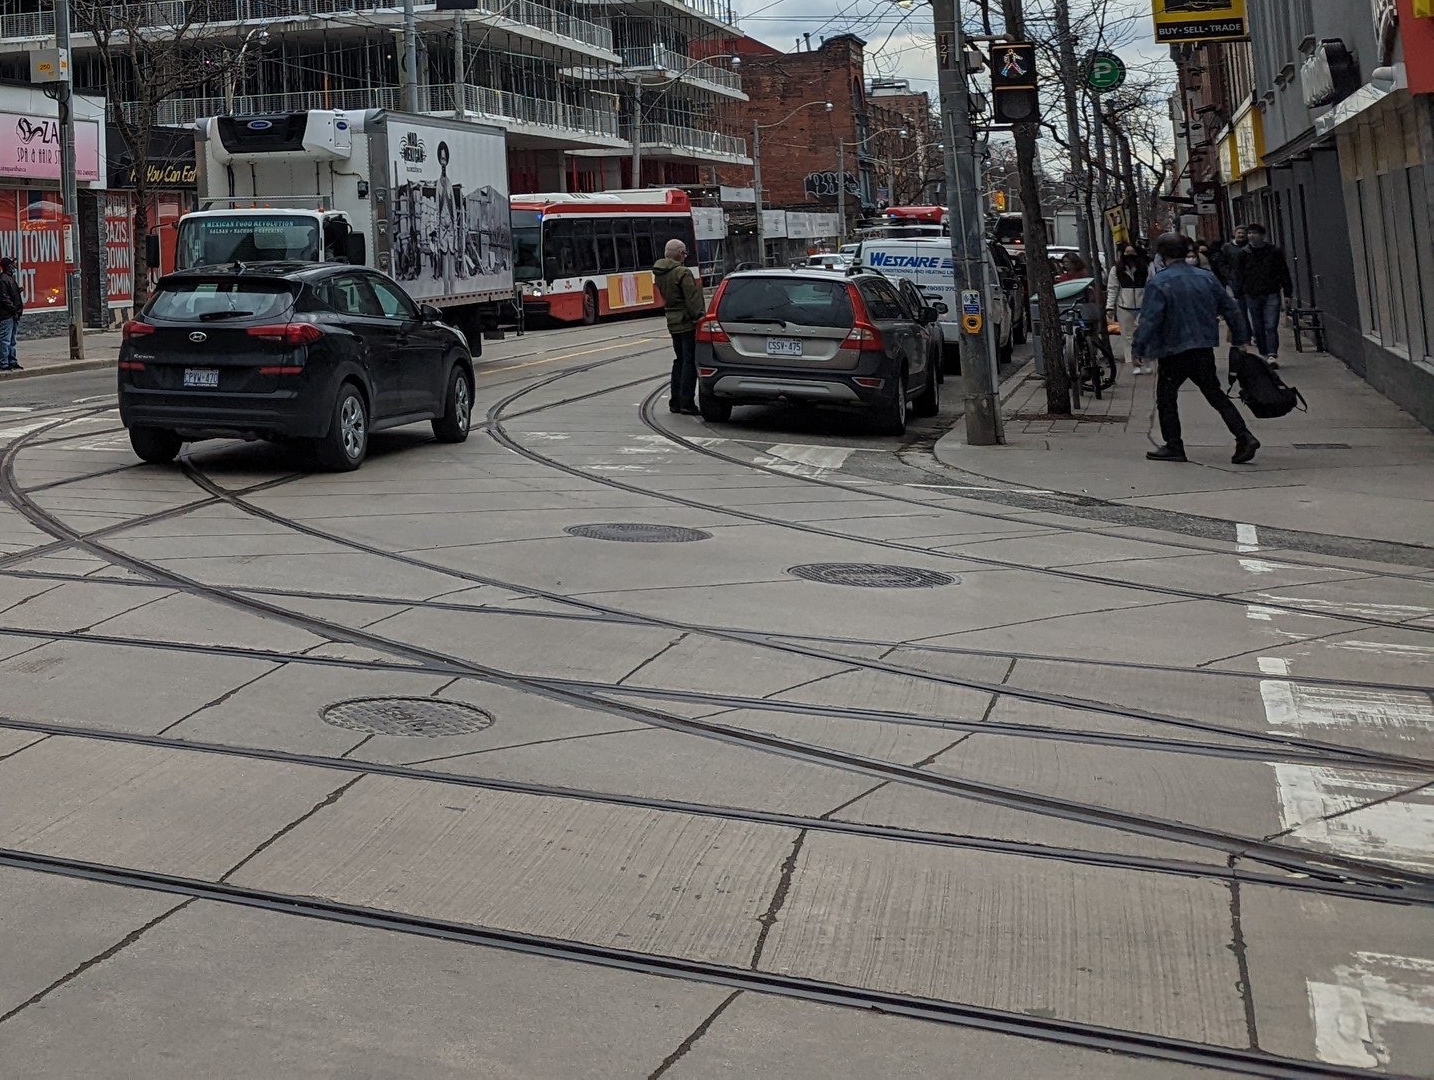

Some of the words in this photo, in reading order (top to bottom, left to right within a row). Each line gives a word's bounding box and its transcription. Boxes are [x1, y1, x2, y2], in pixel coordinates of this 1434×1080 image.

[1158, 27, 1177, 36] BUY
[1183, 25, 1205, 34] SELL
[1209, 23, 1241, 32] TRADE
[16, 146, 28, 163] SPA
[146, 164, 164, 183] You
[164, 165, 181, 183] Can
